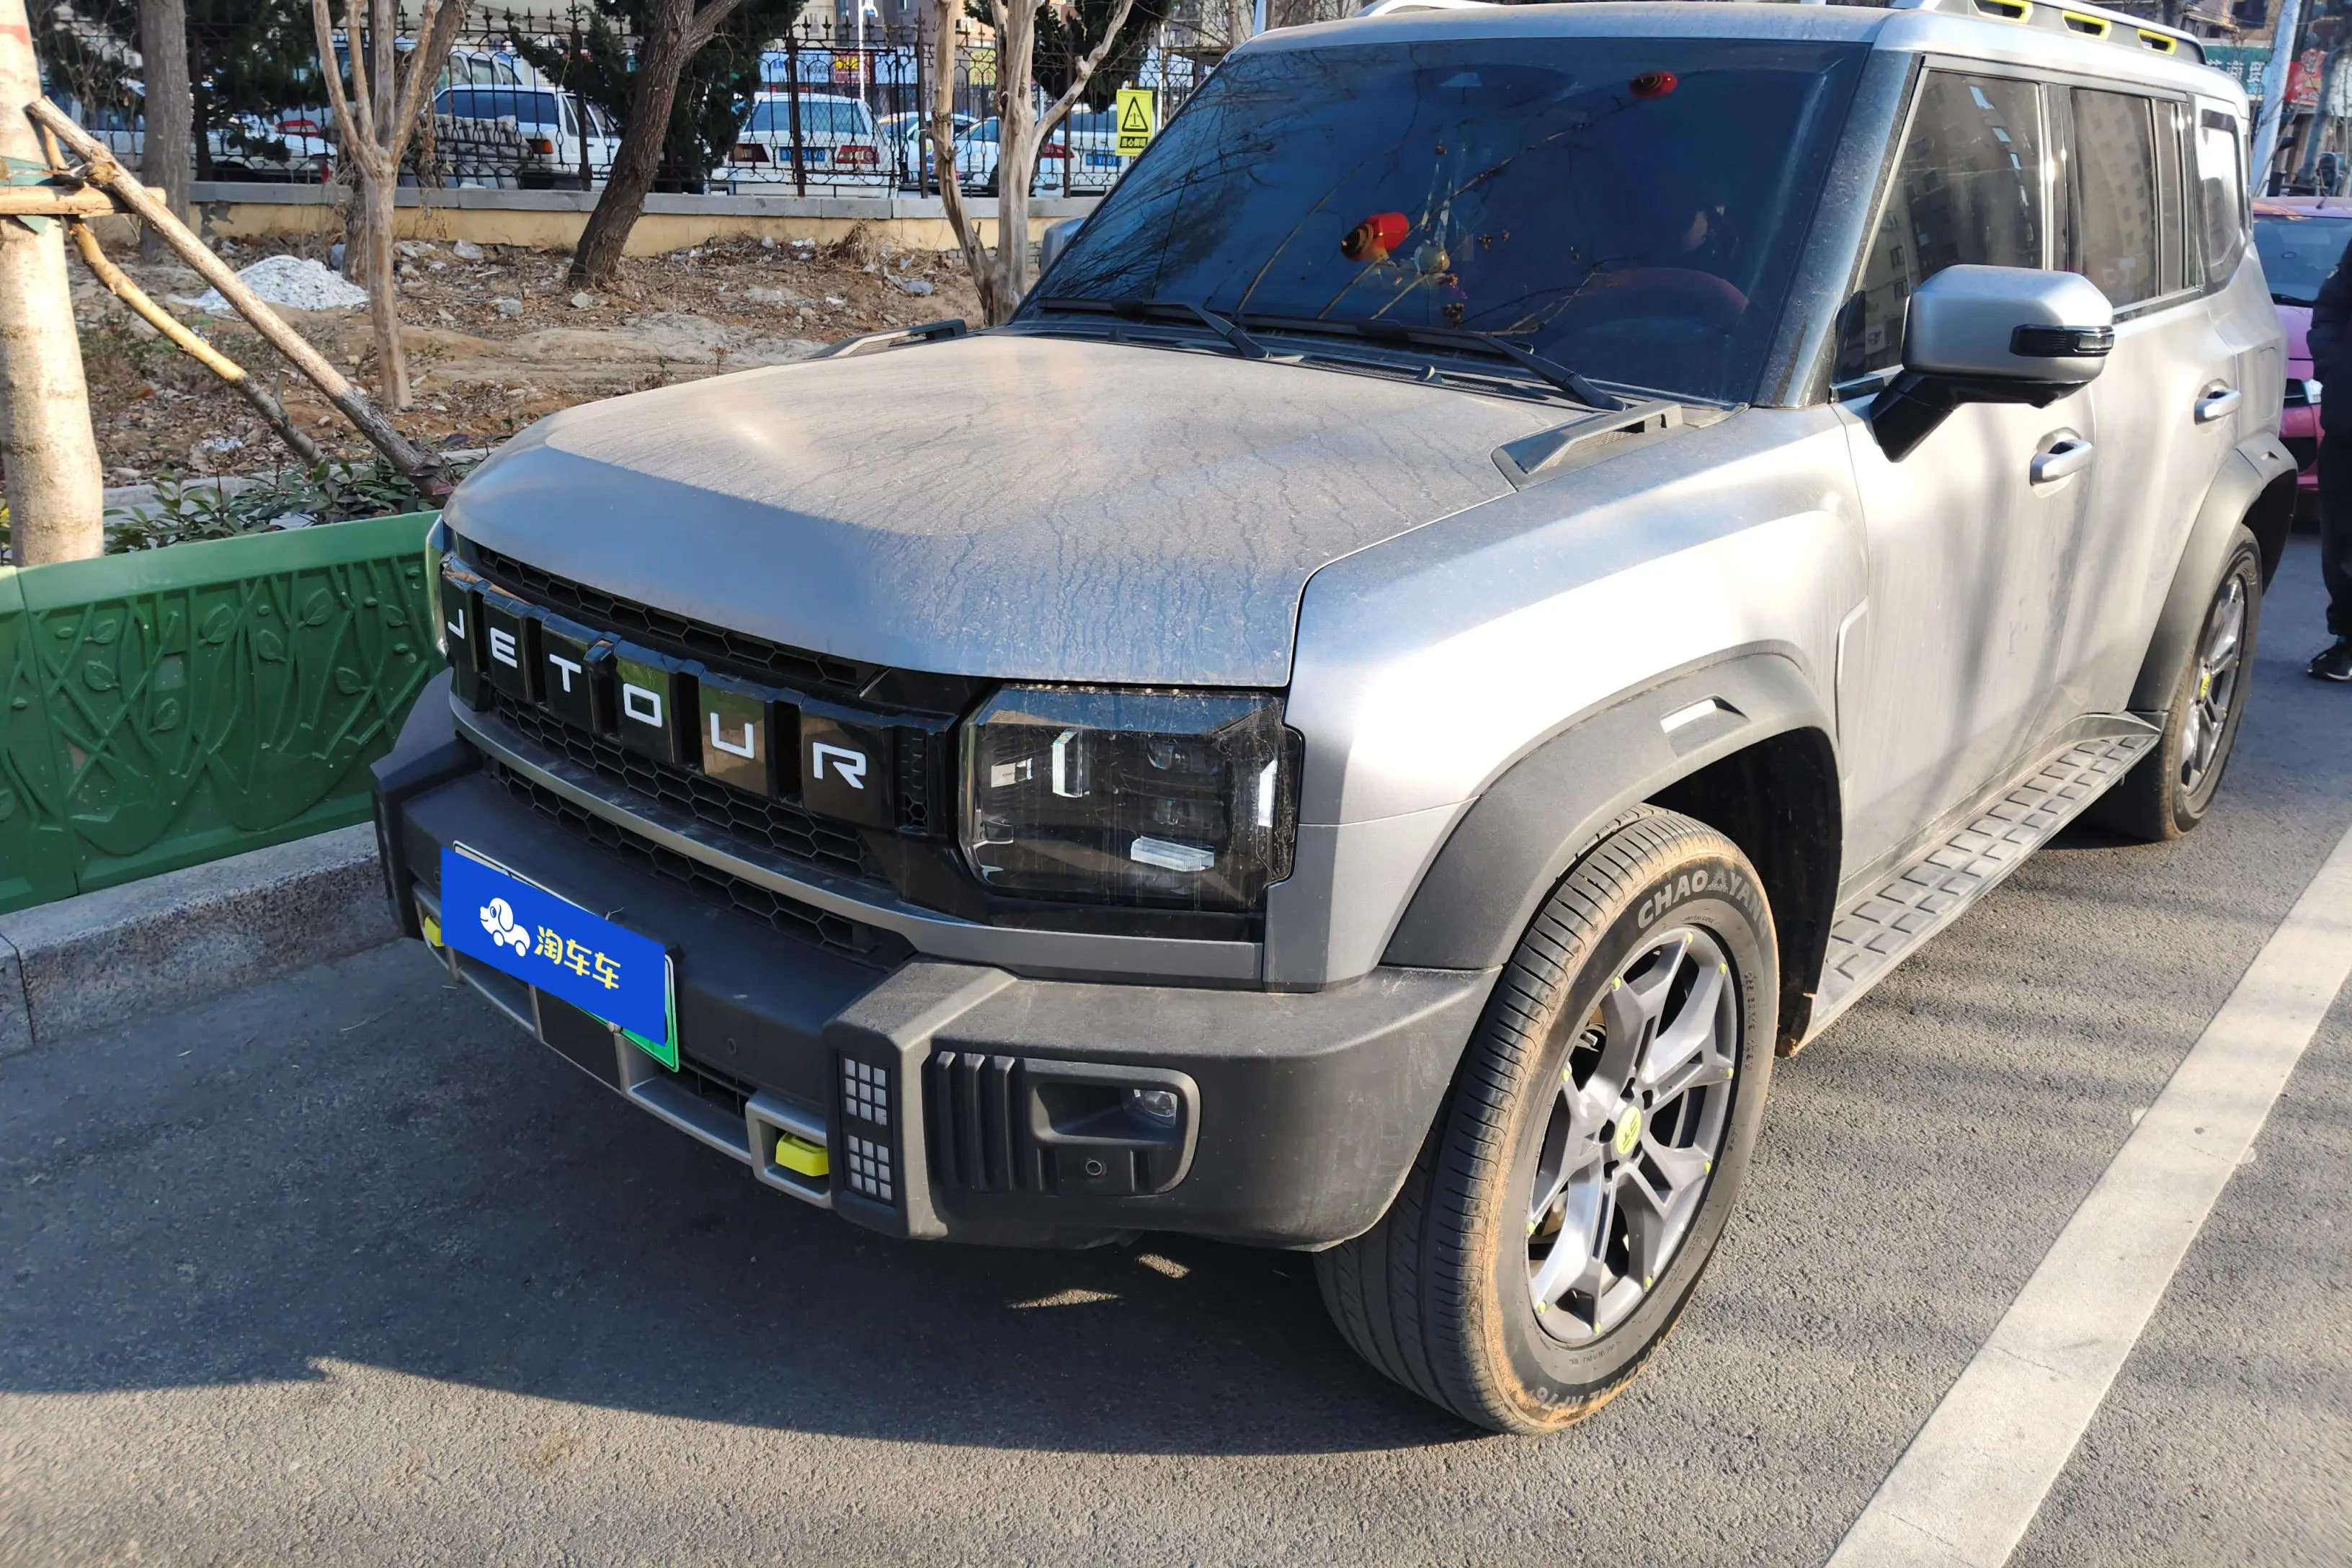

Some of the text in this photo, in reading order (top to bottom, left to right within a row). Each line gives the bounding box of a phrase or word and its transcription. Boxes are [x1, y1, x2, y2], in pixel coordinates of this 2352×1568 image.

[447, 608, 867, 790] JETOUR
[1638, 870, 1769, 937] CHAO YANG
